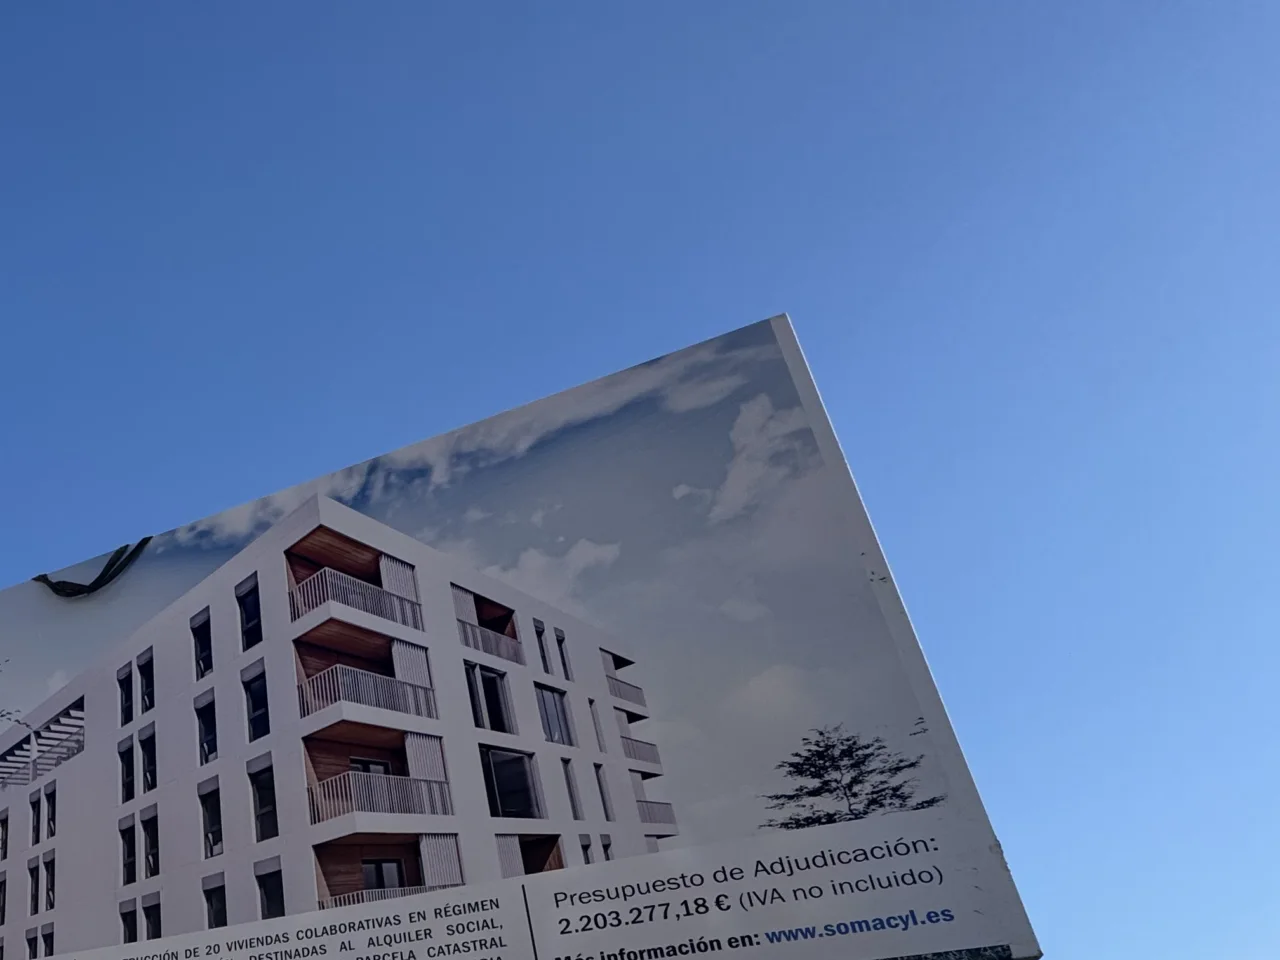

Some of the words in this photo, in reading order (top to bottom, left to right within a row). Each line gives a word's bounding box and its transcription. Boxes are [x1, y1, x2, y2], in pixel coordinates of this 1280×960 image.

[554, 873, 704, 908] Presupuesto
[713, 866, 744, 883] de
[754, 837, 938, 877] Adjudicación:
[558, 897, 709, 934] 2.203.277,18
[715, 894, 731, 911] €
[739, 888, 785, 911] (IVA
[792, 886, 823, 900] no
[831, 865, 942, 895] incluido)
[184, 947, 199, 958] DE
[205, 944, 220, 955] 20
[226, 932, 289, 951] VIVIENDAS
[296, 914, 401, 940] COLABORATIVAS
[408, 910, 426, 923] EN
[434, 898, 499, 918] RÉGIMEN
[339, 940, 355, 951] AL
[367, 928, 432, 947] ALQUILER
[446, 918, 502, 935] SOCIAL,
[427, 936, 506, 957] CATASTRAL
[727, 934, 760, 948] en:
[764, 909, 954, 943] www.somacyl.es
